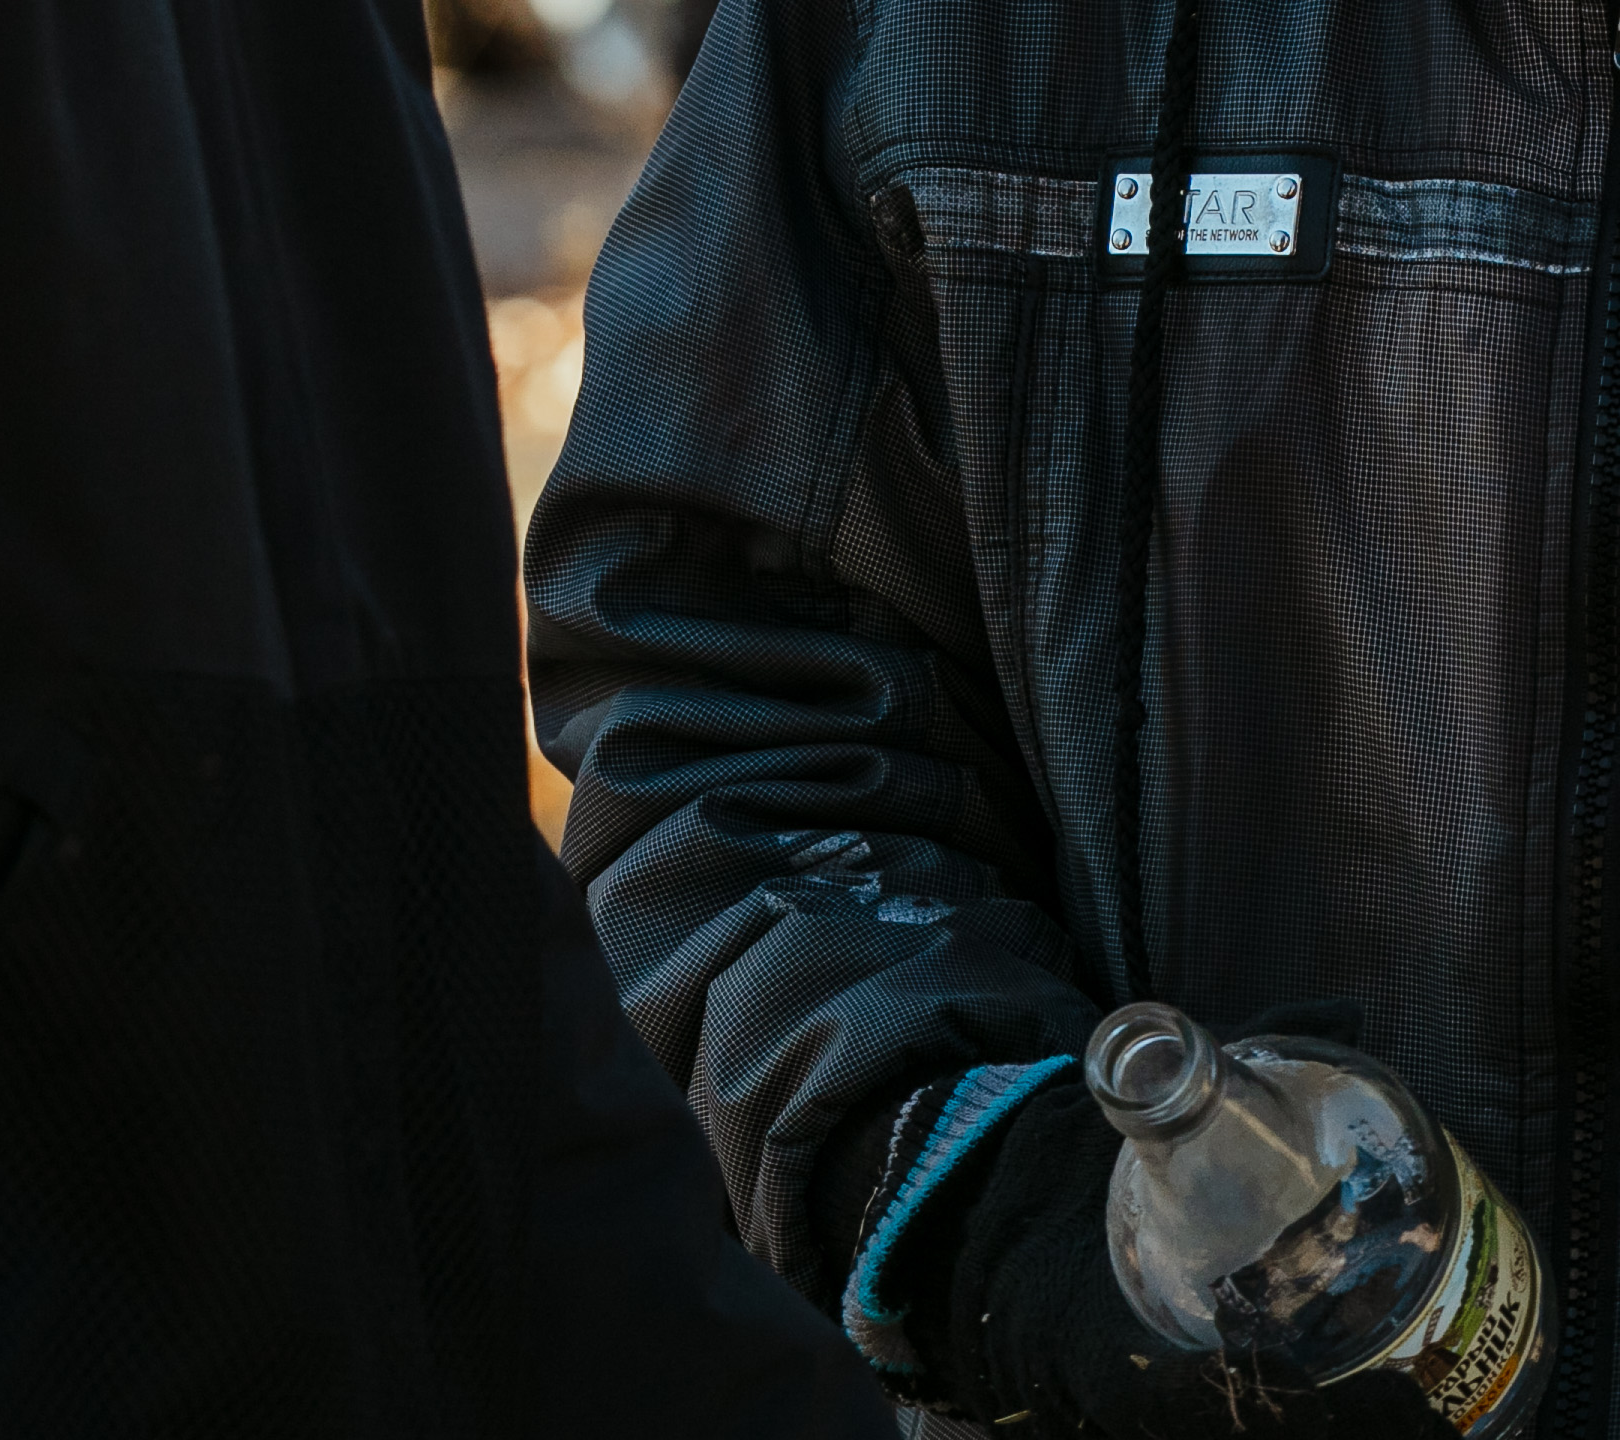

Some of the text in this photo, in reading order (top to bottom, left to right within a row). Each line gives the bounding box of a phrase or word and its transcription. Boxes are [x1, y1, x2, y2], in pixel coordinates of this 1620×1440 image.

[1180, 188, 1258, 224] TAR
[1190, 229, 1208, 241] THE
[1209, 229, 1259, 241] NETWORK
[1442, 1291, 1521, 1417] льник
[1452, 1340, 1515, 1420] ОЧОНКА
